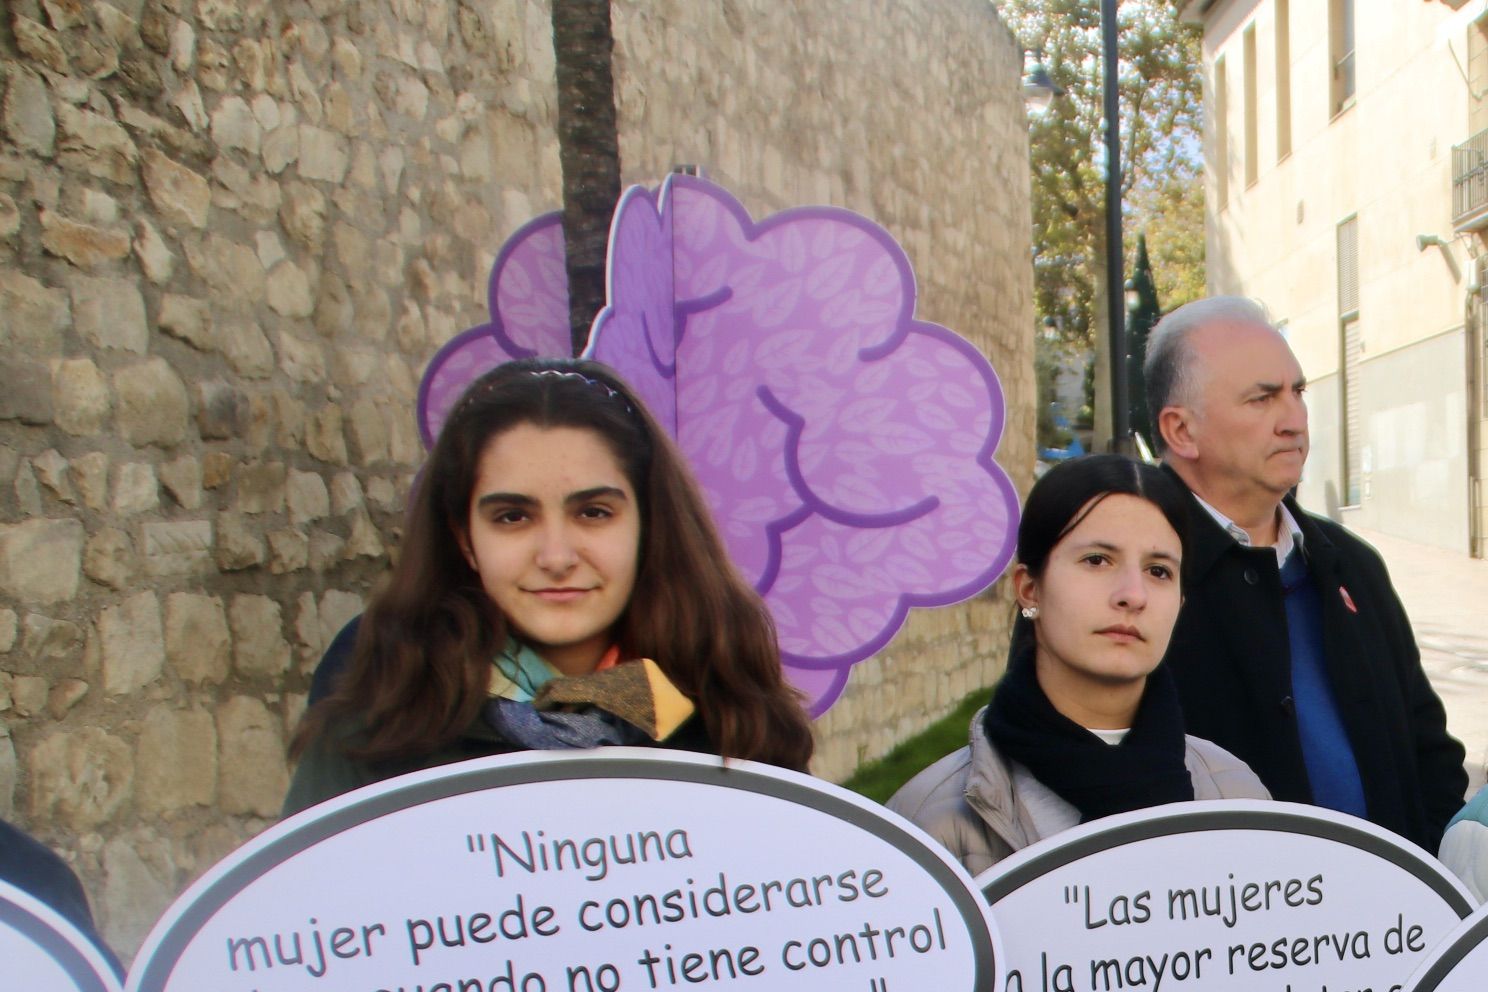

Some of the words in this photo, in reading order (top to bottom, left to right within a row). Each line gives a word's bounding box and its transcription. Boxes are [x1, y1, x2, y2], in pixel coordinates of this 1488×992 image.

[467, 830, 693, 881] "Ninguna
[228, 918, 385, 977] mujer
[407, 894, 560, 966] puede
[579, 869, 888, 931] considerarse
[1065, 885, 1151, 929] "Las
[1168, 873, 1323, 928] mujeres
[638, 944, 765, 989] tiene
[782, 908, 946, 971] control
[1228, 931, 1371, 975] reserva
[1384, 913, 1427, 955] de
